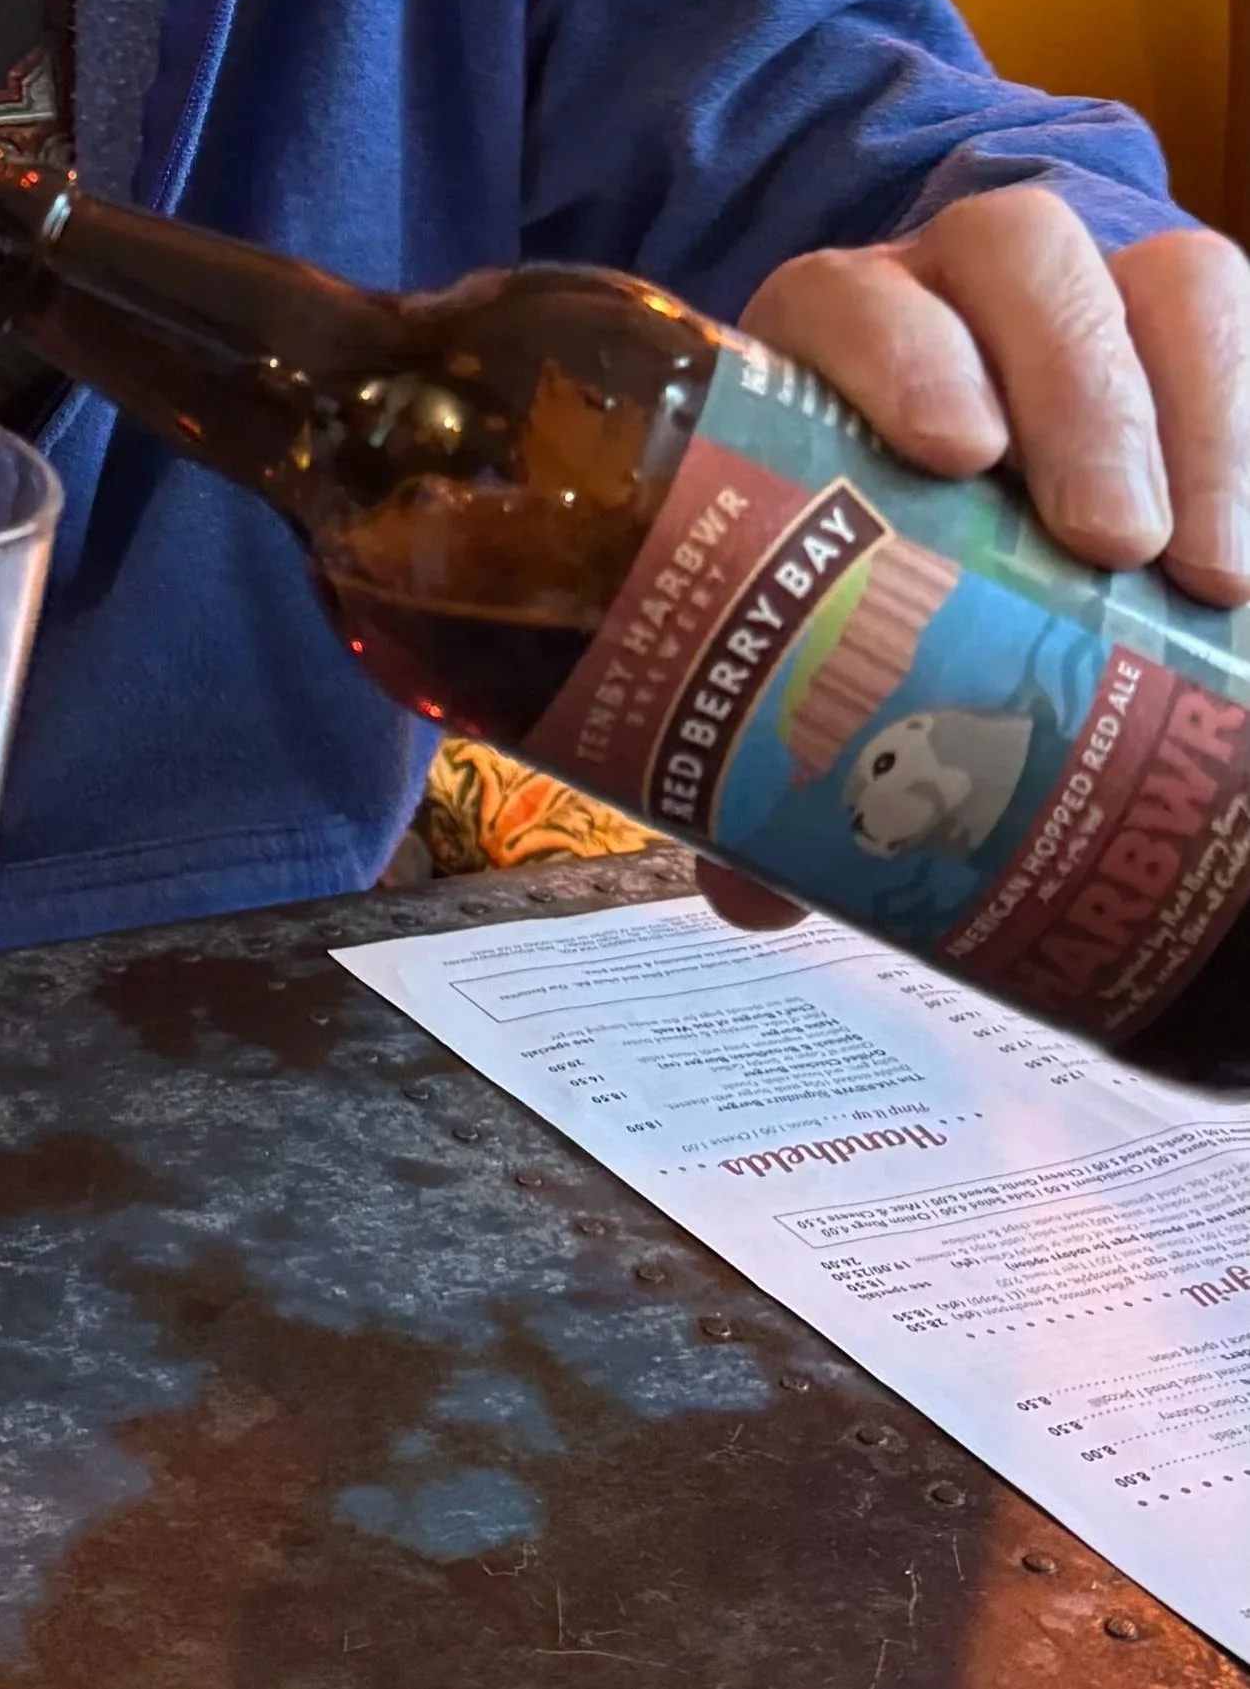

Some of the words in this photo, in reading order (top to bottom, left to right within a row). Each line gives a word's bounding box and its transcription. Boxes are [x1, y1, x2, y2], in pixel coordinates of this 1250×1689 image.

[776, 506, 858, 597] BAY
[576, 662, 638, 764] TENBY
[626, 485, 749, 654] HARBWR
[679, 592, 785, 750] BERRY
[1027, 752, 1096, 867] HOPPED
[1081, 711, 1124, 779] RED
[1109, 658, 1144, 720] ALE
[661, 754, 701, 823] RED
[1018, 686, 1247, 1004] HARBWR
[521, 1042, 570, 1058] specials
[744, 1067, 789, 1077] Burger
[570, 1075, 605, 1086] 16.50
[592, 1092, 627, 1103] 18.50
[852, 1110, 872, 1120] up
[888, 1103, 930, 1115] Pimp
[626, 1120, 662, 1132] 18.00
[718, 1123, 948, 1179] Handhelds
[1152, 1153, 1178, 1166] 4.00
[999, 1179, 1038, 1189] Garlic
[959, 1187, 999, 1199] Bread
[969, 1197, 1006, 1209] Salad
[889, 1213, 931, 1223] Onion
[821, 1226, 849, 1237] 4.00
[847, 1278, 885, 1291] 18.50
[1180, 1264, 1250, 1308] grill
[858, 1286, 907, 1300] specials
[893, 1309, 932, 1321] 18.50
[906, 1318, 947, 1332] 28.50
[1017, 1397, 1051, 1411] 8.50
[1048, 1422, 1081, 1436] 8.50
[1081, 1446, 1116, 1461] 8.00
[1115, 1472, 1150, 1487] 8.00
